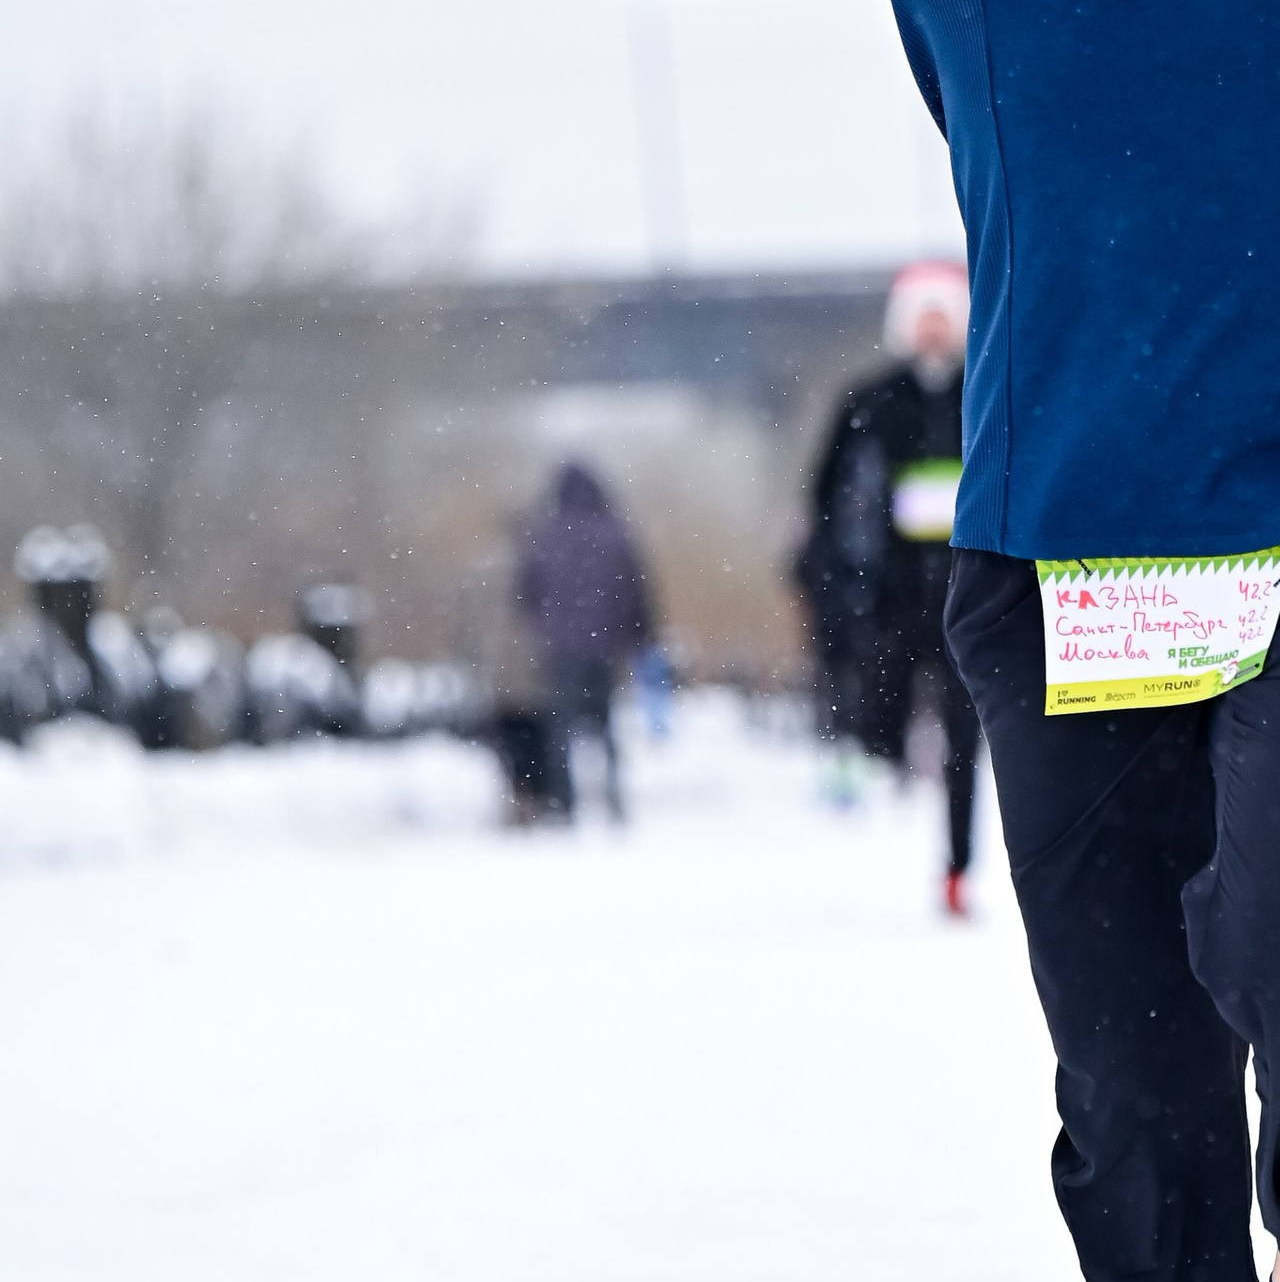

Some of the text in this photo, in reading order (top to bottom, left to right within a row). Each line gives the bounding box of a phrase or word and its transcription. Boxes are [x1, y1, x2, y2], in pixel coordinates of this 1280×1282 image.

[1056, 610, 1228, 641] Санкт-Петербург
[1059, 633, 1150, 662] Москва
[1167, 645, 1210, 659] Я БЕГУ
[1178, 649, 1239, 669] И ОБЕЩАЮ
[1057, 696, 1097, 706] RUNNING
